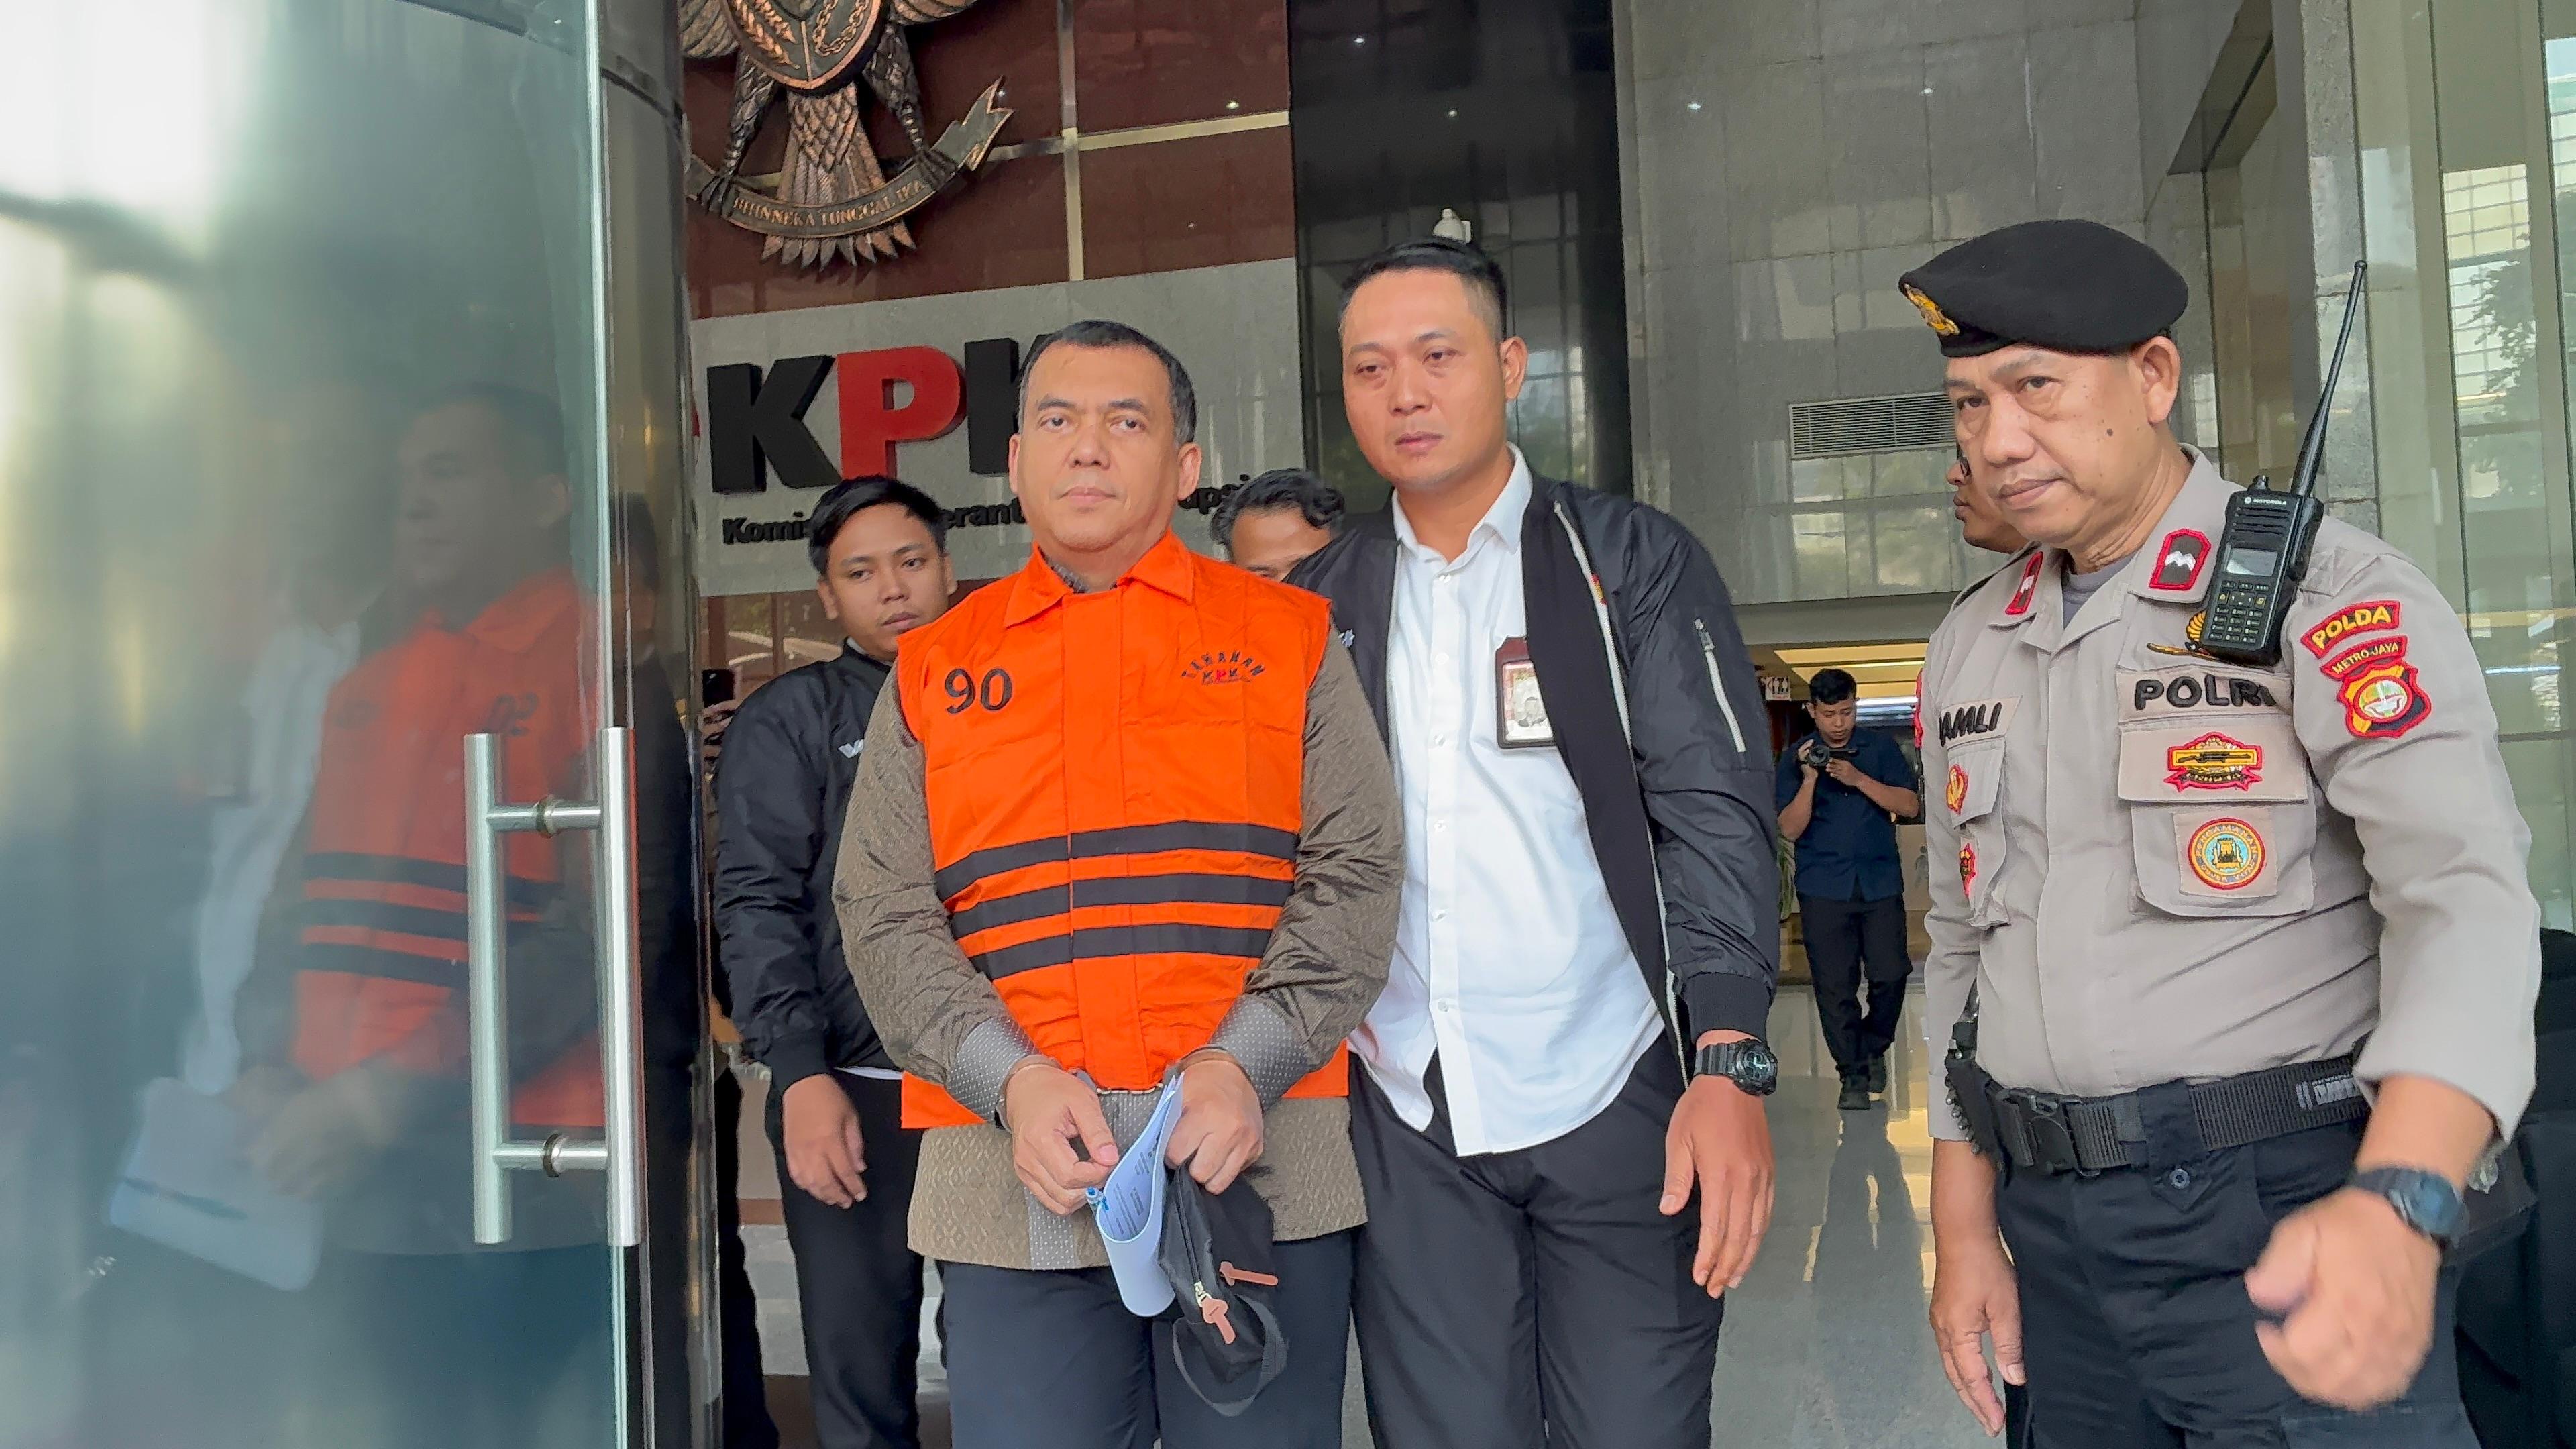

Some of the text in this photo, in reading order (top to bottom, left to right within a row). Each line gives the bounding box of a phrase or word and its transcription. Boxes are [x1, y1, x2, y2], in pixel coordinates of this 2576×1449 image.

[733, 180, 926, 226] BHINNEKA TUNGGAL IKA
[2253, 498, 2287, 506] MOTOROLA
[722, 511, 810, 545] Komi
[2312, 605, 2392, 649] POLDA
[2332, 642, 2399, 674] METRO JAYA
[945, 667, 1013, 714] 90
